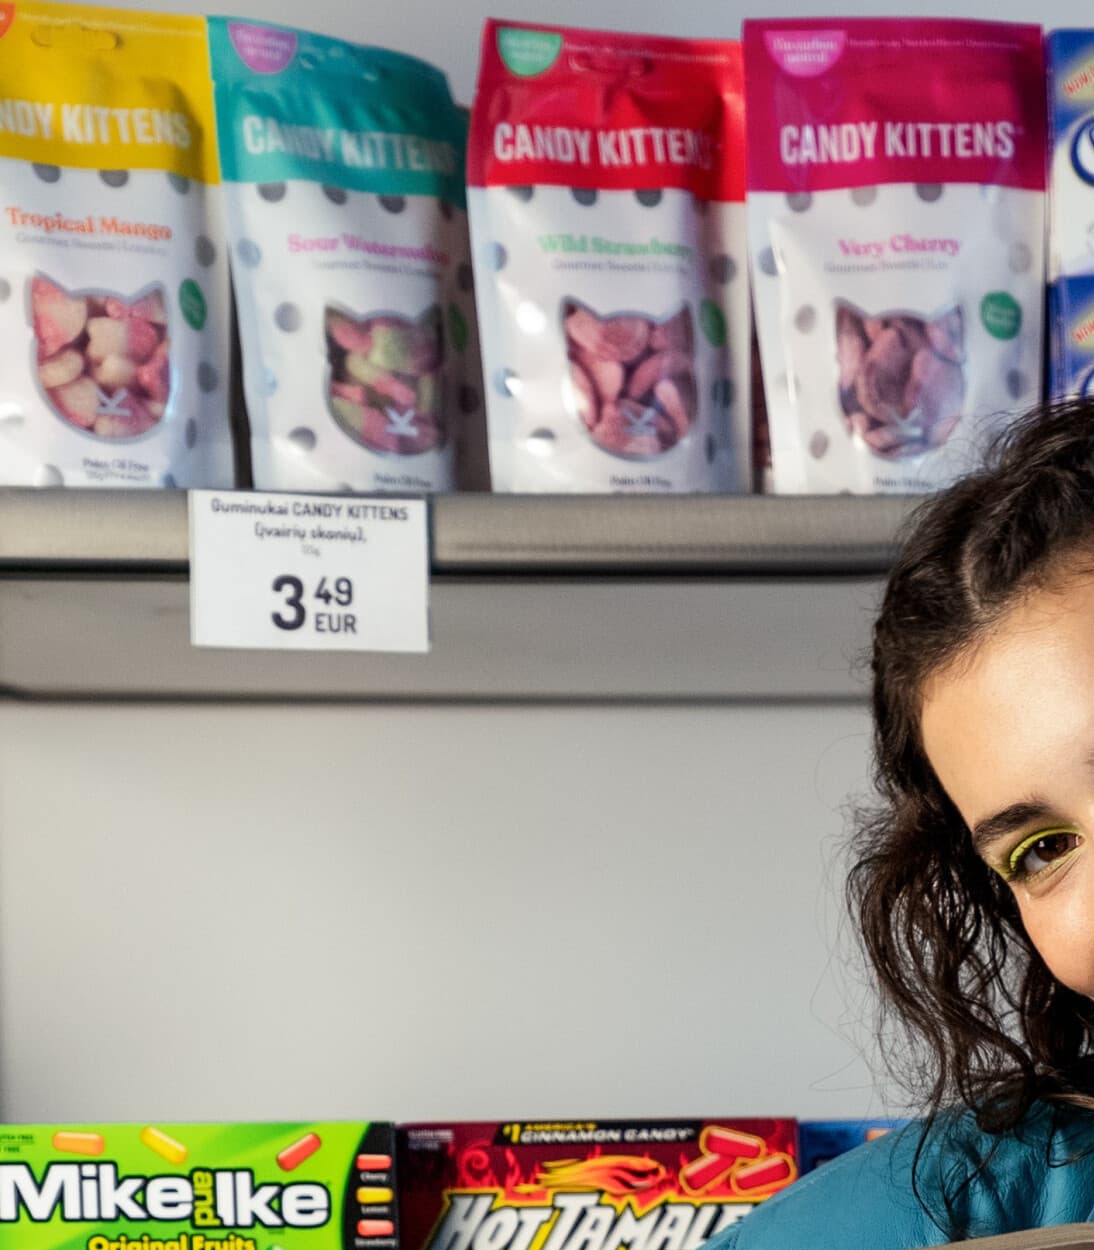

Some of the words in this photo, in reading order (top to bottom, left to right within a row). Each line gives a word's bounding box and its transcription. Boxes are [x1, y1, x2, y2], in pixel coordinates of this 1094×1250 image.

[0, 103, 53, 142] NDY
[62, 103, 191, 149] KITTENS
[241, 115, 336, 165] CANDY
[494, 122, 590, 166] CANDY
[780, 122, 878, 164] CANDY
[885, 121, 1016, 160] KITTENS
[5, 206, 95, 234] Tropical
[99, 215, 173, 241] Mango
[838, 239, 884, 257] Very
[889, 233, 961, 257] Cherry
[293, 501, 342, 519] CANDY
[348, 505, 408, 521] KITTENS
[271, 574, 306, 631] 3
[314, 576, 353, 606] 49
[315, 612, 357, 634] EUR
[520, 1129, 620, 1143] CINNAMON
[624, 1128, 694, 1141] CANDY
[0, 1163, 193, 1221] Mike
[216, 1170, 330, 1227] Ike
